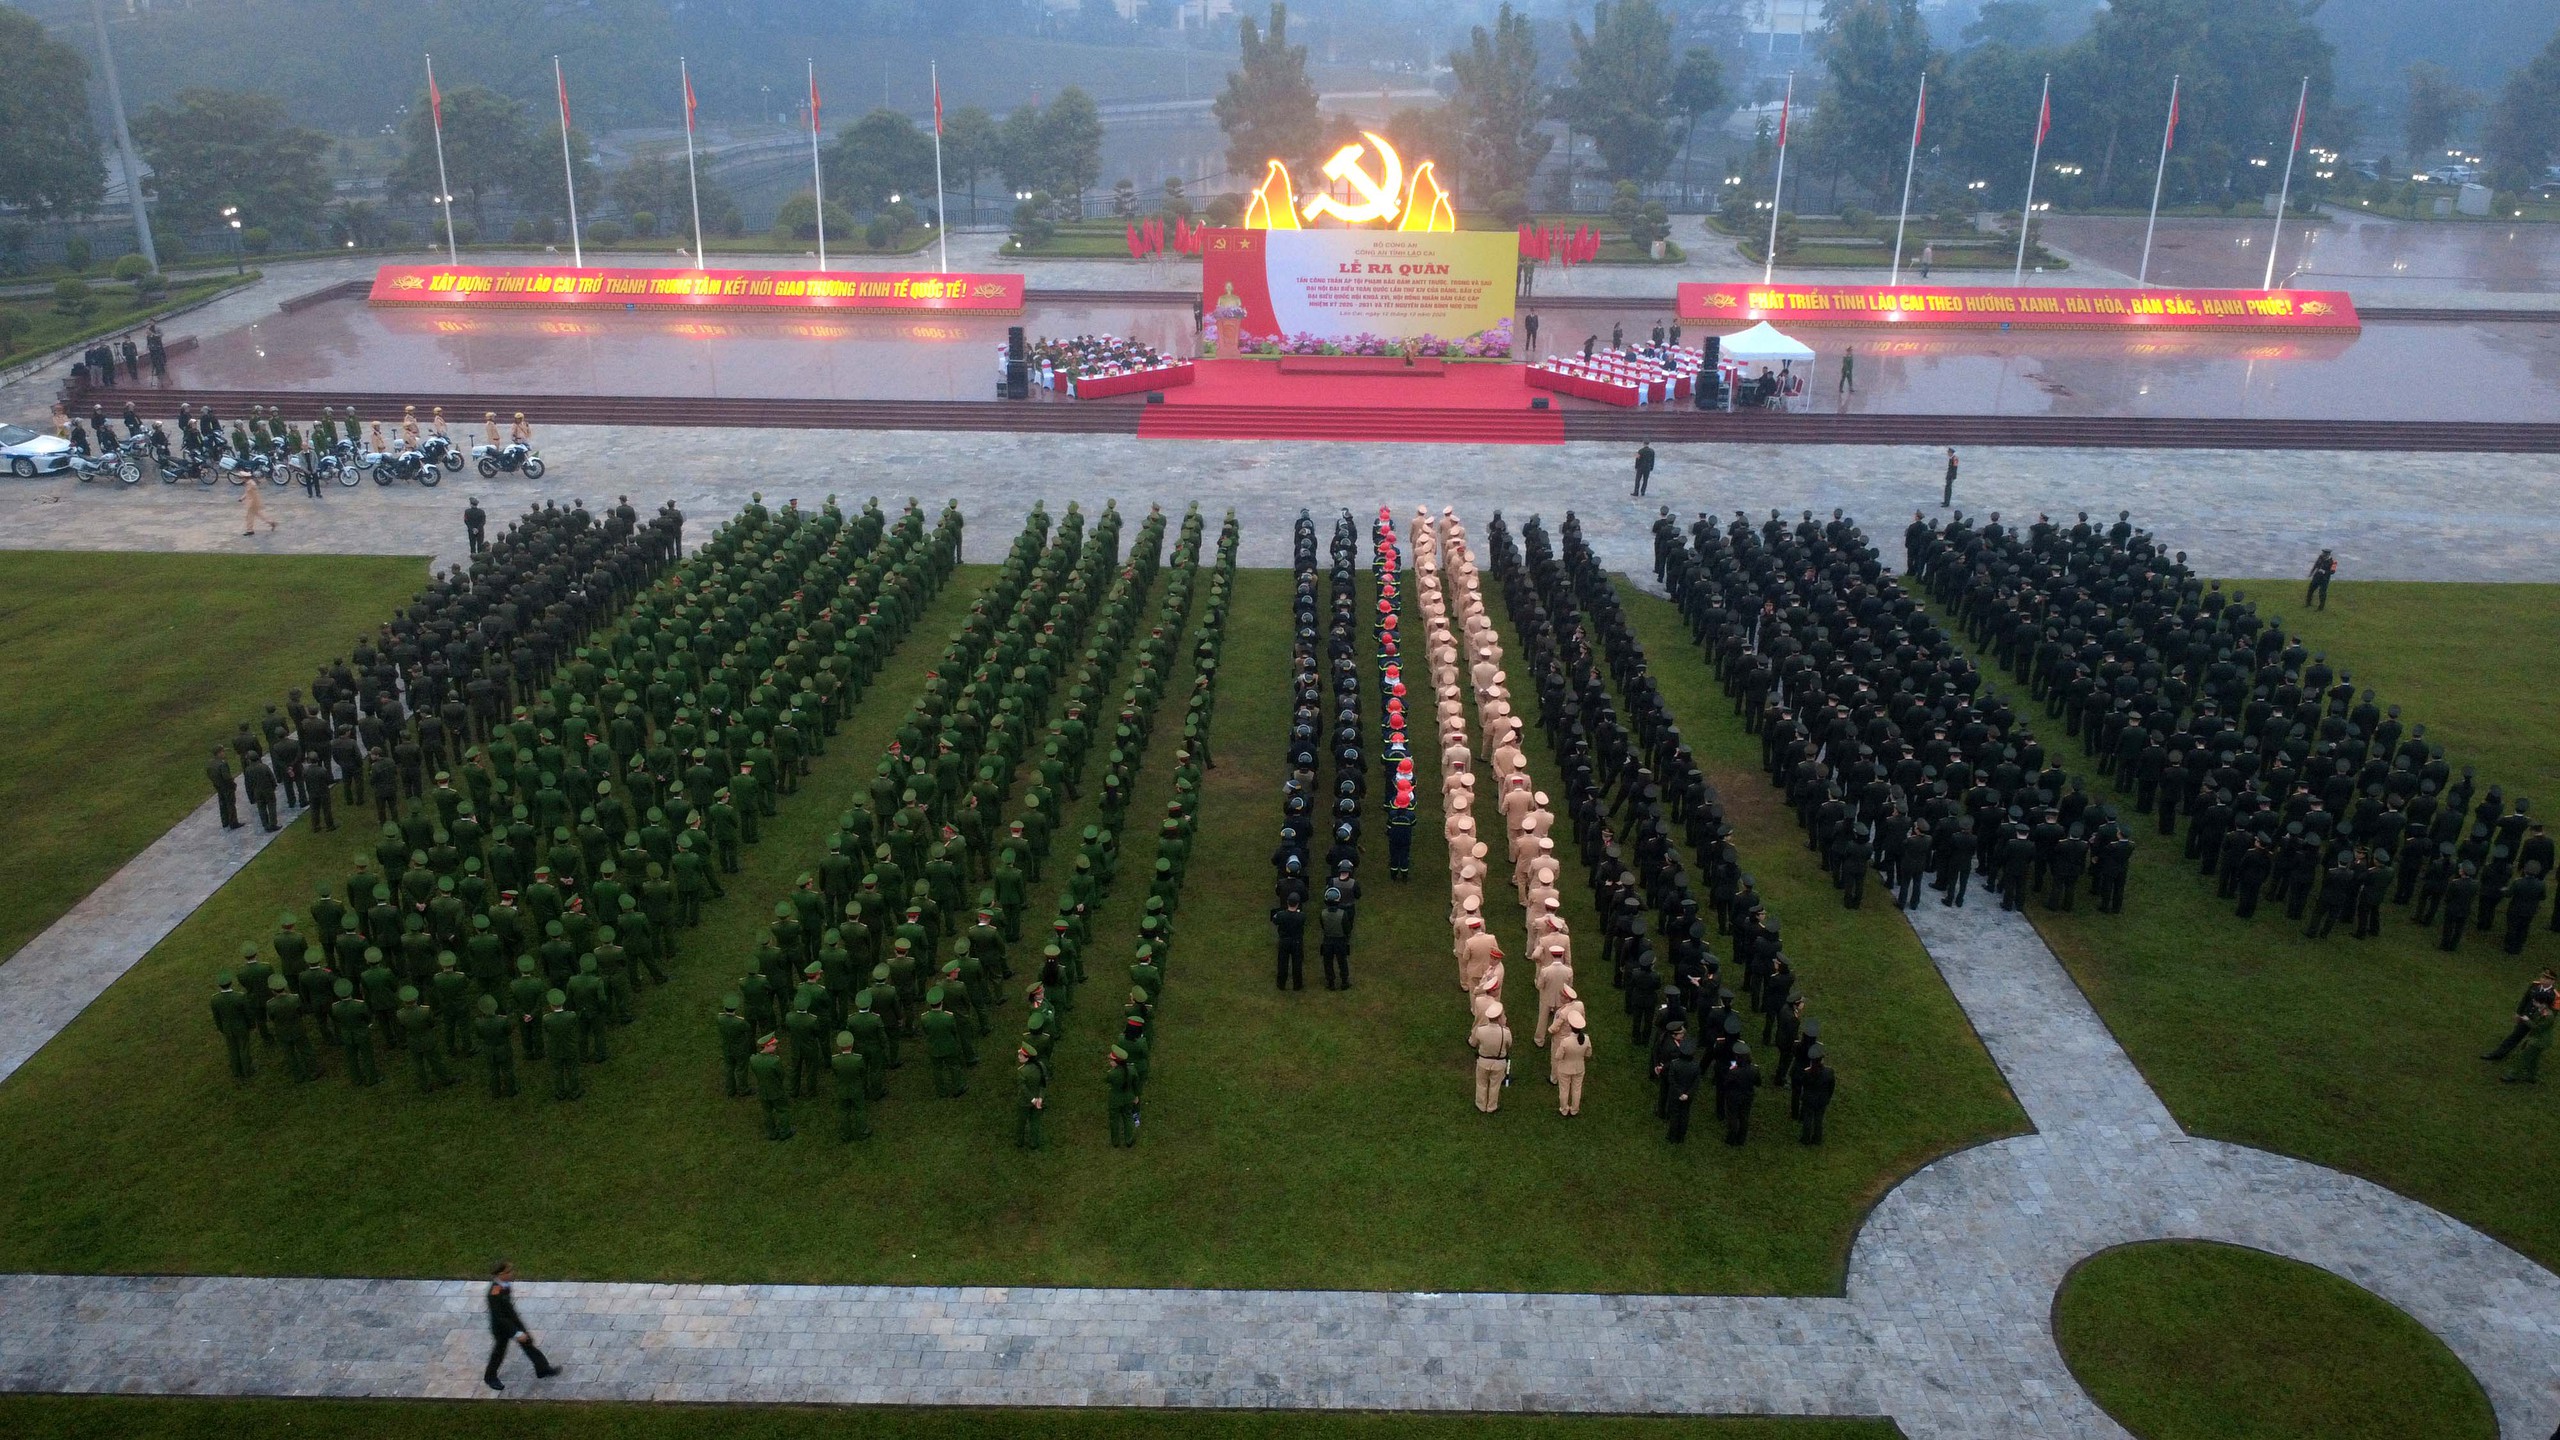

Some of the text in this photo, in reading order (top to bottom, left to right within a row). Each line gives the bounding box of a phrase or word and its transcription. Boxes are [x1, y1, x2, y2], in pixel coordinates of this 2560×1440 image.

[1339, 259, 1450, 276] LỄ RA QUÂN
[428, 272, 456, 292] XÂY
[456, 276, 492, 296] DỰNG
[496, 272, 524, 292] TỈNH
[526, 274, 551, 293] LÀO
[553, 277, 576, 293] CAI
[578, 273, 603, 293] TRỞ
[605, 275, 646, 294] THÀNH
[650, 278, 694, 295] TRUNG
[694, 276, 721, 295] TÂM
[724, 276, 747, 295] KẾT
[750, 276, 772, 296] NỐI
[775, 280, 804, 296] GIAO
[807, 279, 856, 297] THƯƠNG
[859, 282, 889, 298] KINH
[893, 278, 910, 298] TẾ
[910, 278, 943, 299] QUỐC
[1748, 288, 2292, 318] PHÁT TRIỂN TỈNH LÀO CAI THEO HƯỚNG XANH, HÀI HÒA, BẢN SẮC, HẠNH PHÚC!
